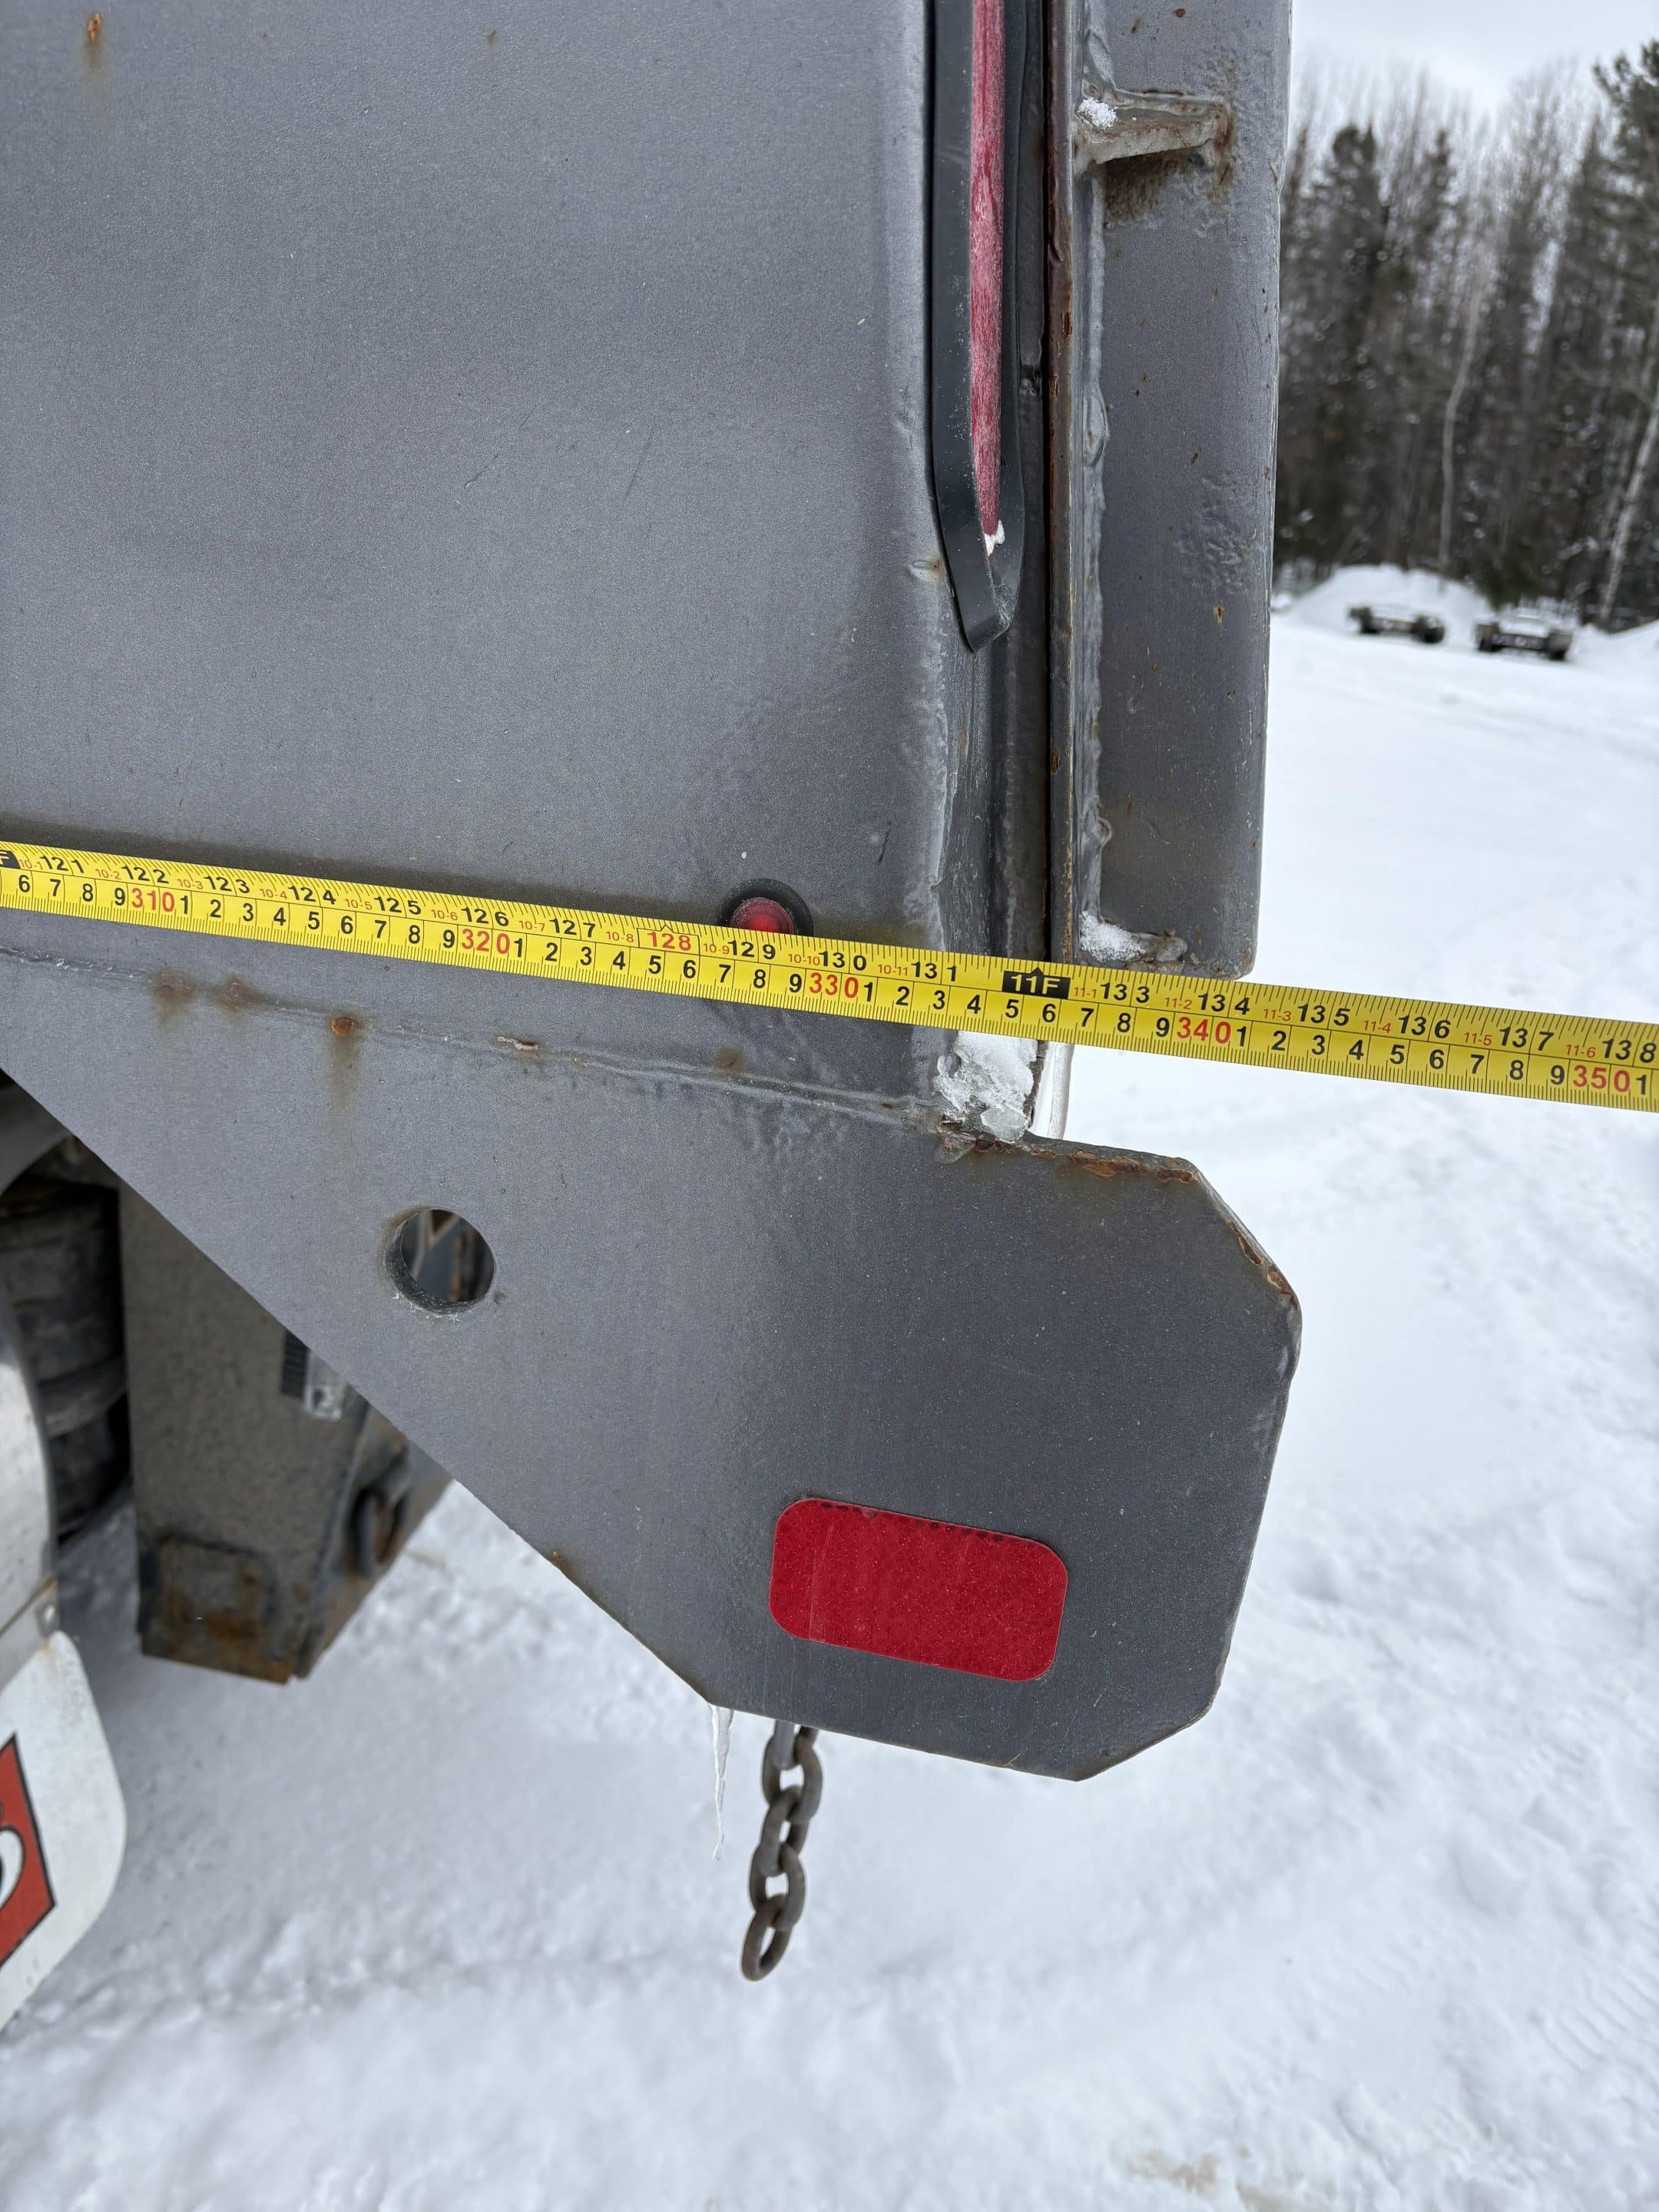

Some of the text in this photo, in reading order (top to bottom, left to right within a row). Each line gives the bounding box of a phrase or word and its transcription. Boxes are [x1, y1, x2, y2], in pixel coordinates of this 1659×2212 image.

[18, 875, 1646, 1095] 6 7 8 9 310 1 2 3 4 5 6 7 8 9 320 1 2 3 4 5 6 7 8 9 330 1 2 3 4 5 6 7 8 9 340 1 2 3 4 5 6 7 8 9 350 1
[19, 859, 43, 870] 10-1
[95, 869, 121, 880] 10-2
[178, 879, 204, 890] 10-3
[260, 889, 288, 900] 10-4
[345, 898, 373, 910] 10-5
[431, 909, 458, 921] 10-6
[519, 920, 546, 932] 10-7
[606, 931, 634, 943] 10-8
[647, 932, 691, 951] 128
[704, 943, 730, 955] 10-9
[787, 953, 820, 965] 10-10
[877, 964, 909, 975] 10-11
[1011, 974, 1060, 995] 11F
[1074, 986, 1098, 998] 11-1
[1164, 998, 1192, 1009] 11-2
[1263, 1008, 1291, 1021] 11-3
[1363, 1020, 1391, 1033] 11-4
[1464, 1031, 1492, 1045] 11-5
[1566, 1044, 1596, 1058] 11-6
